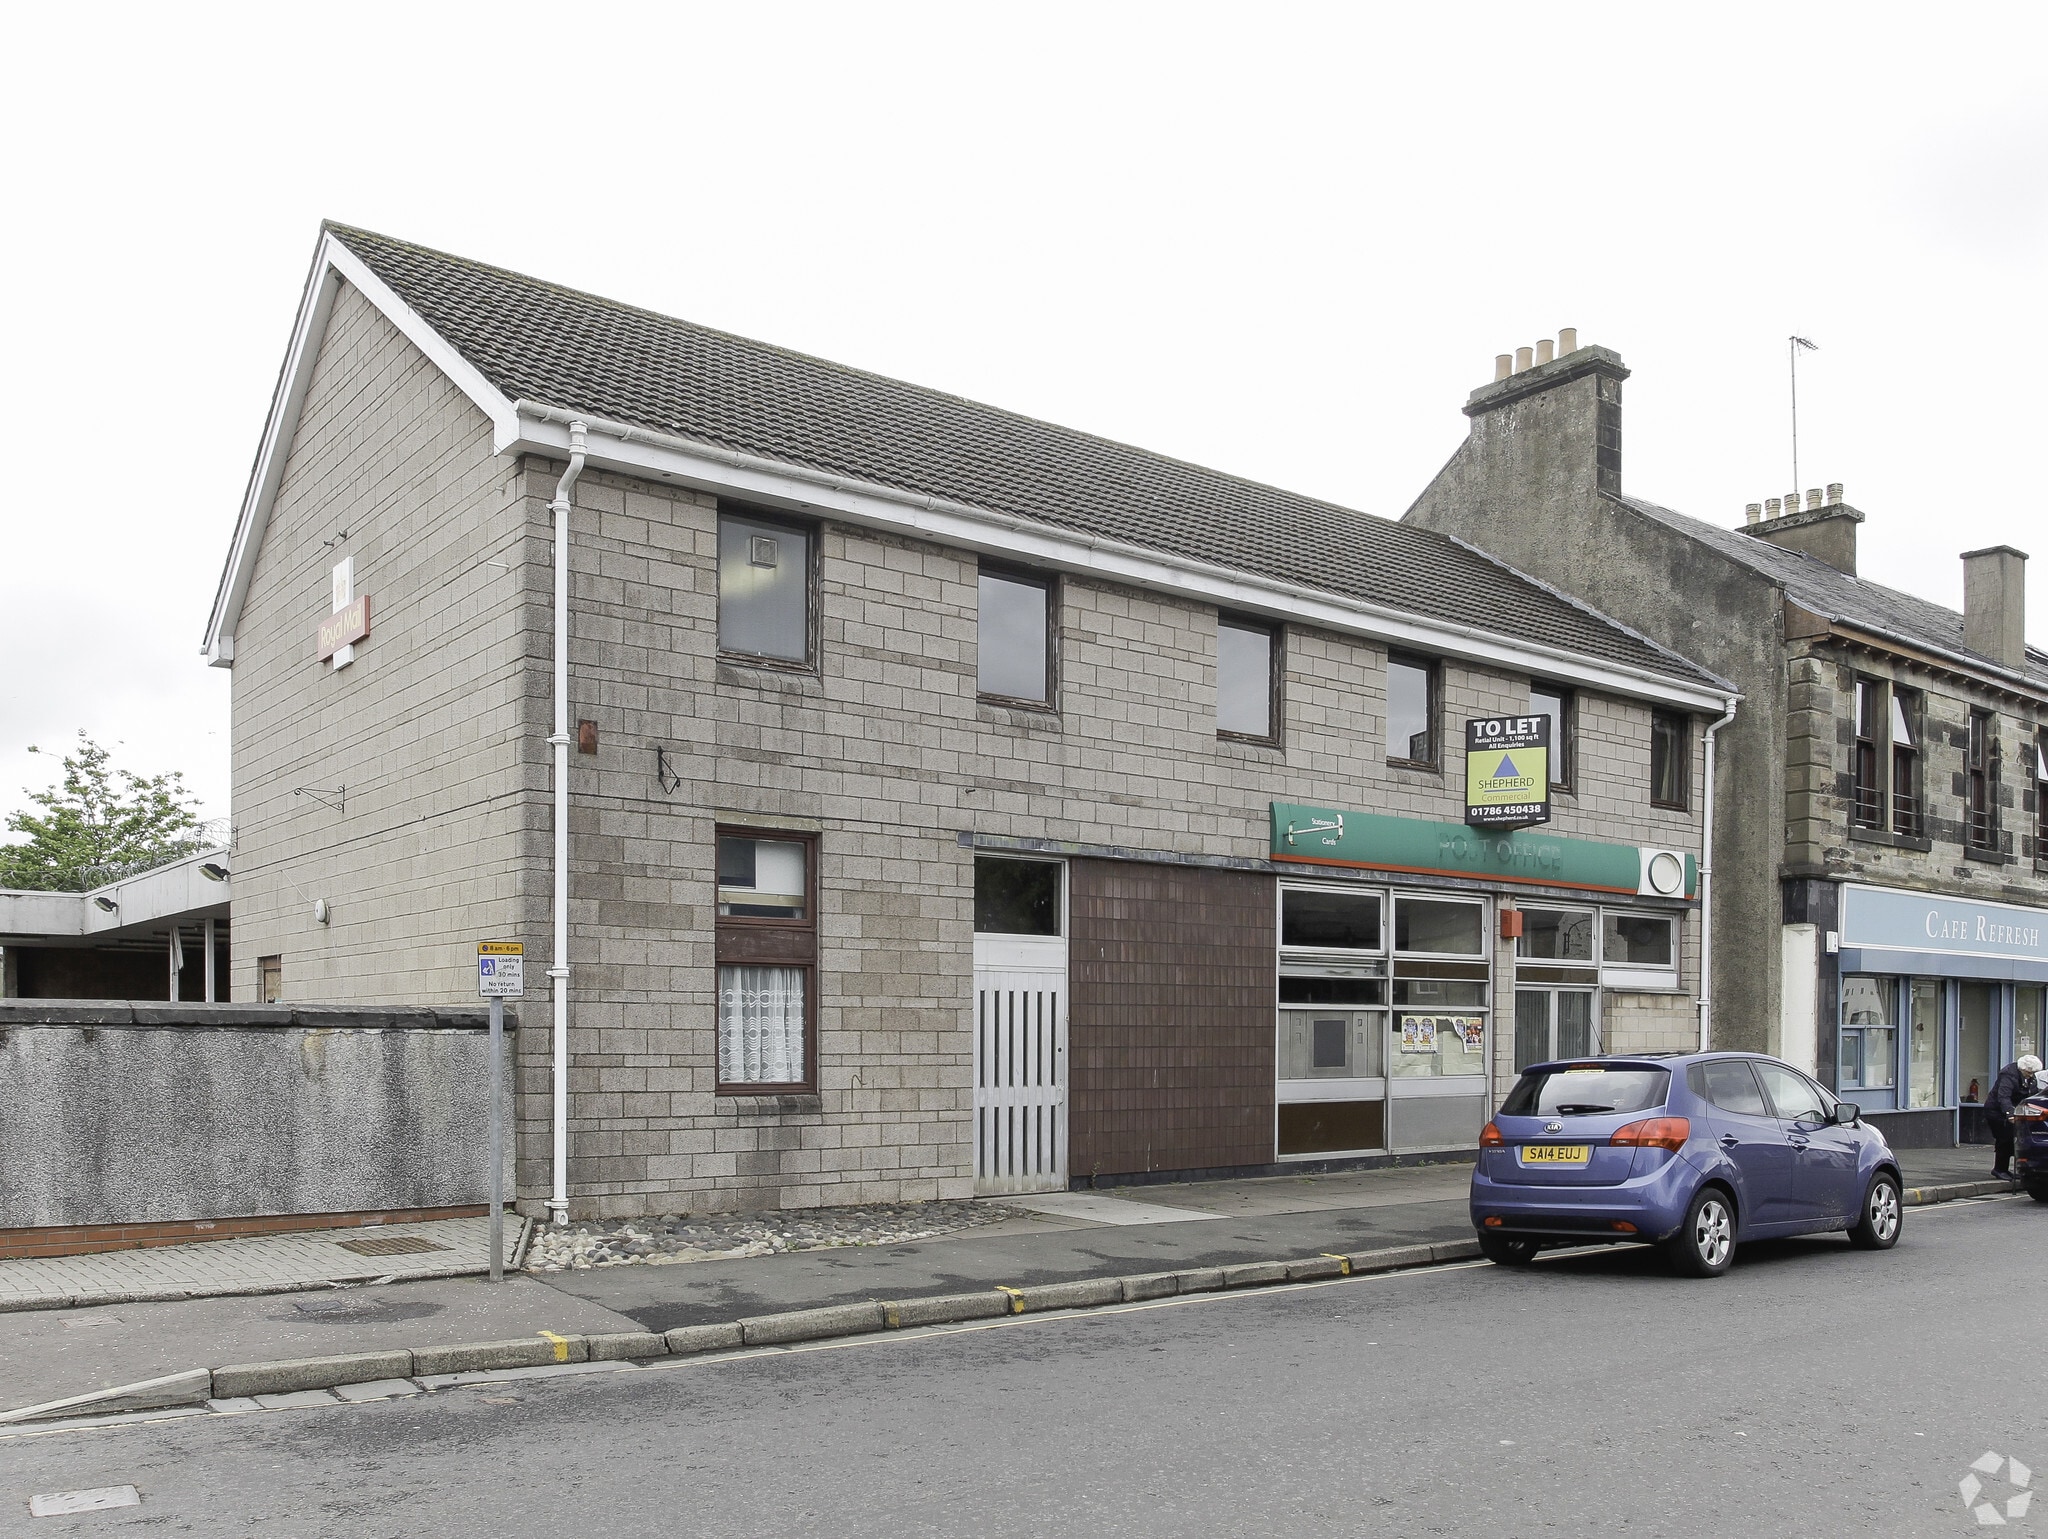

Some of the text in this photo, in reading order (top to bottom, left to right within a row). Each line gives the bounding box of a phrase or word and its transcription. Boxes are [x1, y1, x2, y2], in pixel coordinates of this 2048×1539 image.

[321, 603, 361, 648] Royal Mail
[1473, 718, 1541, 737] TO LET
[1497, 741, 1525, 749] Enquiries
[1478, 777, 1535, 790] SHEPHERD
[1481, 792, 1531, 803] Commercial
[1471, 804, 1541, 816] 01786 450438
[1311, 817, 1336, 827] Stationery
[1321, 836, 1337, 846] Cards
[1496, 839, 1560, 871] OFFICE
[1925, 910, 2039, 947] CAFE REFRESH
[1530, 1148, 1581, 1159] SA14 EUJ
